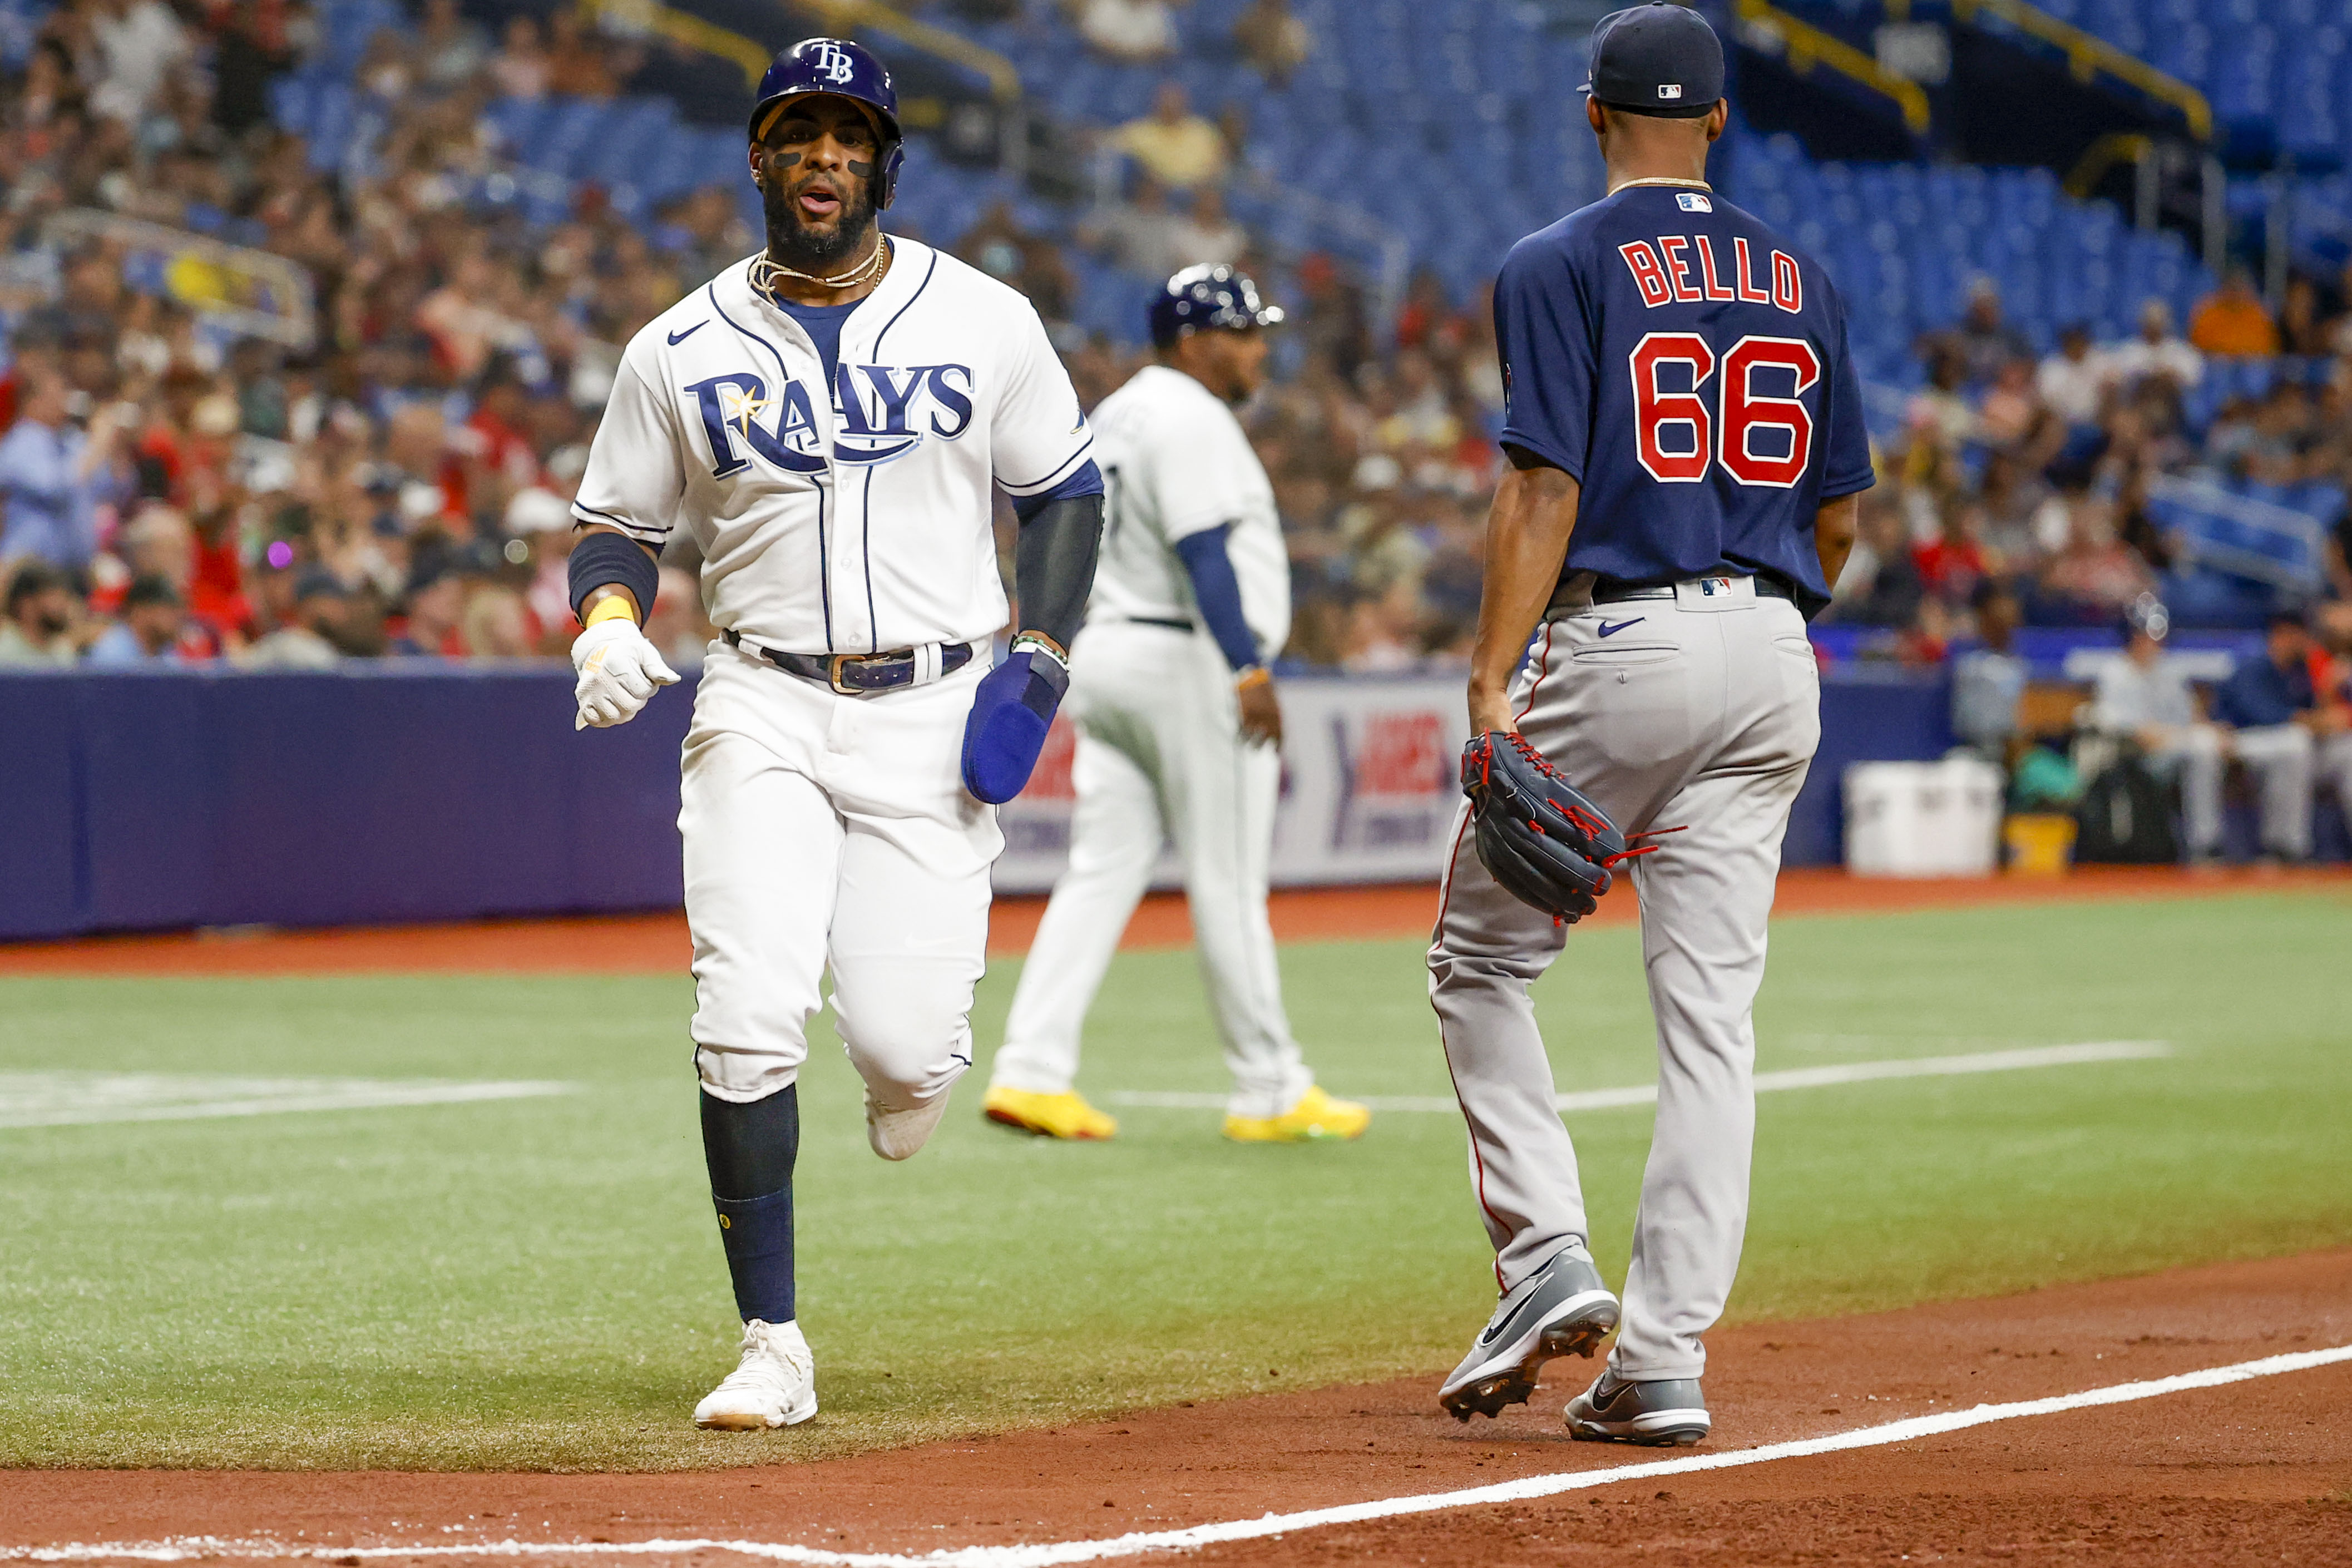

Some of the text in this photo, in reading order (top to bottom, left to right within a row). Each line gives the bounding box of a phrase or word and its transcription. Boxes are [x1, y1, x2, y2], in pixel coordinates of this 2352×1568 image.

[810, 43, 853, 83] TB
[1618, 234, 1802, 314] BELLO
[684, 363, 975, 482] RAYS
[1628, 332, 1821, 488] 66
